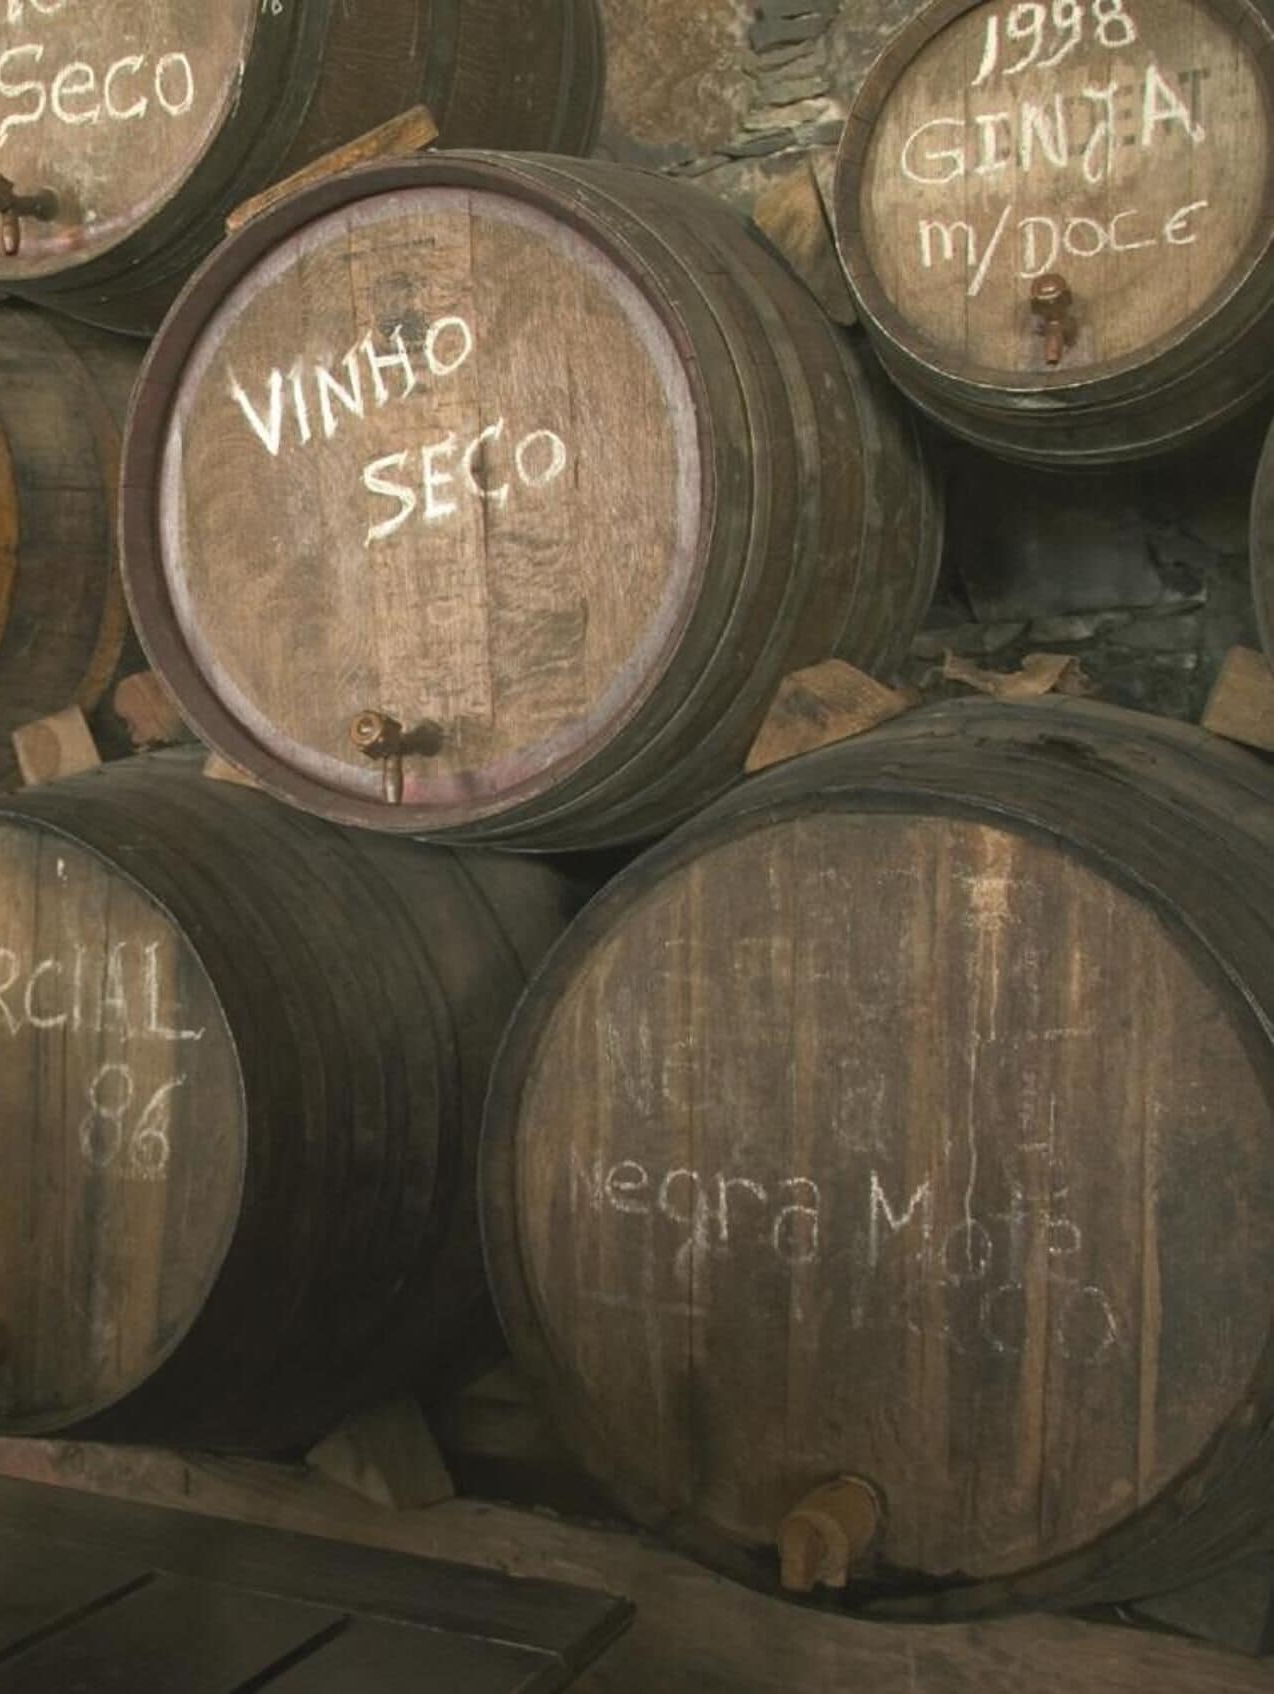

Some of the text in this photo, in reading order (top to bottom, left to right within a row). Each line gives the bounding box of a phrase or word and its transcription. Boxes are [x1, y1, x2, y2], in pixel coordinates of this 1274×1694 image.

[971, 0, 1137, 86] 1998
[901, 63, 1206, 184] GINJA
[226, 315, 473, 456] VINHO
[360, 416, 567, 547] SECO
